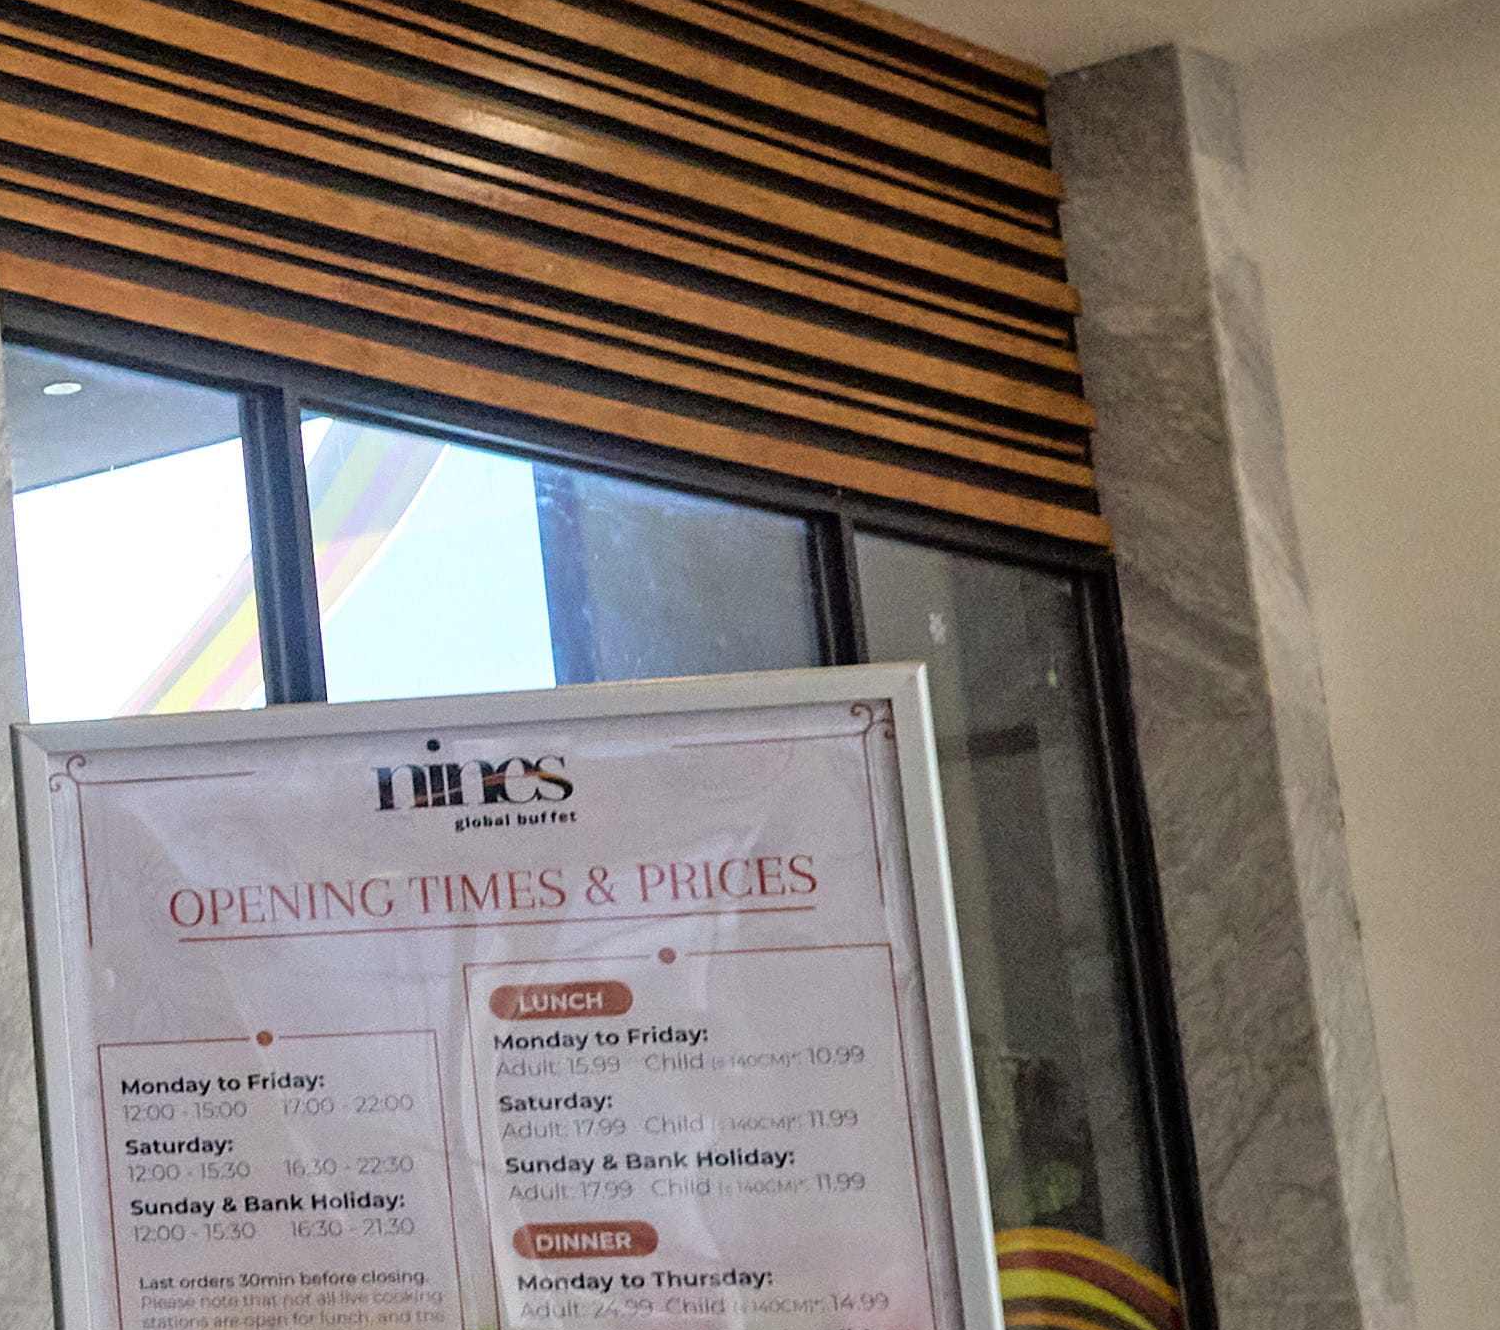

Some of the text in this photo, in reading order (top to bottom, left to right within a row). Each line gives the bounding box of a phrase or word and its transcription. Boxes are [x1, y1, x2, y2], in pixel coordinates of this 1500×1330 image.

[370, 738, 574, 812] nines
[454, 810, 578, 833] global buffet
[169, 854, 818, 928] OPENING TIMES & PRICES
[518, 991, 603, 1013] LUNCH
[494, 1024, 708, 1053] Monday to Friday:
[644, 1052, 703, 1071] Child
[808, 1046, 864, 1065] 10.99
[121, 1070, 325, 1097] Monday to Friday:
[499, 1093, 613, 1115] Saturday:
[644, 1115, 704, 1135] Child
[808, 1109, 858, 1129] 11.99
[125, 1136, 233, 1157] Saturday:
[505, 1148, 795, 1177] Sunday & Bank Holiday:
[651, 1177, 711, 1198] Child
[816, 1172, 866, 1192] 11.99
[130, 1190, 405, 1218] Sunday & Bank Holiday:
[535, 1231, 632, 1253] DINNER
[139, 1276, 175, 1291] Last
[179, 1275, 235, 1290] orders
[239, 1272, 295, 1288] 30min
[300, 1270, 356, 1287] before
[517, 1268, 773, 1295] Monday to Thursday:
[141, 1294, 196, 1310] Please
[200, 1294, 238, 1309] note
[243, 1293, 278, 1308] that
[283, 1292, 311, 1308] not
[317, 1290, 335, 1306] all
[373, 1288, 443, 1308] cooking
[666, 1297, 726, 1316] Child
[830, 1293, 889, 1312] 14.99
[142, 1315, 209, 1330] stations
[213, 1316, 239, 1329] are
[244, 1314, 287, 1330] open
[292, 1312, 315, 1327] for
[377, 1310, 411, 1325] and
[416, 1309, 445, 1324] the
